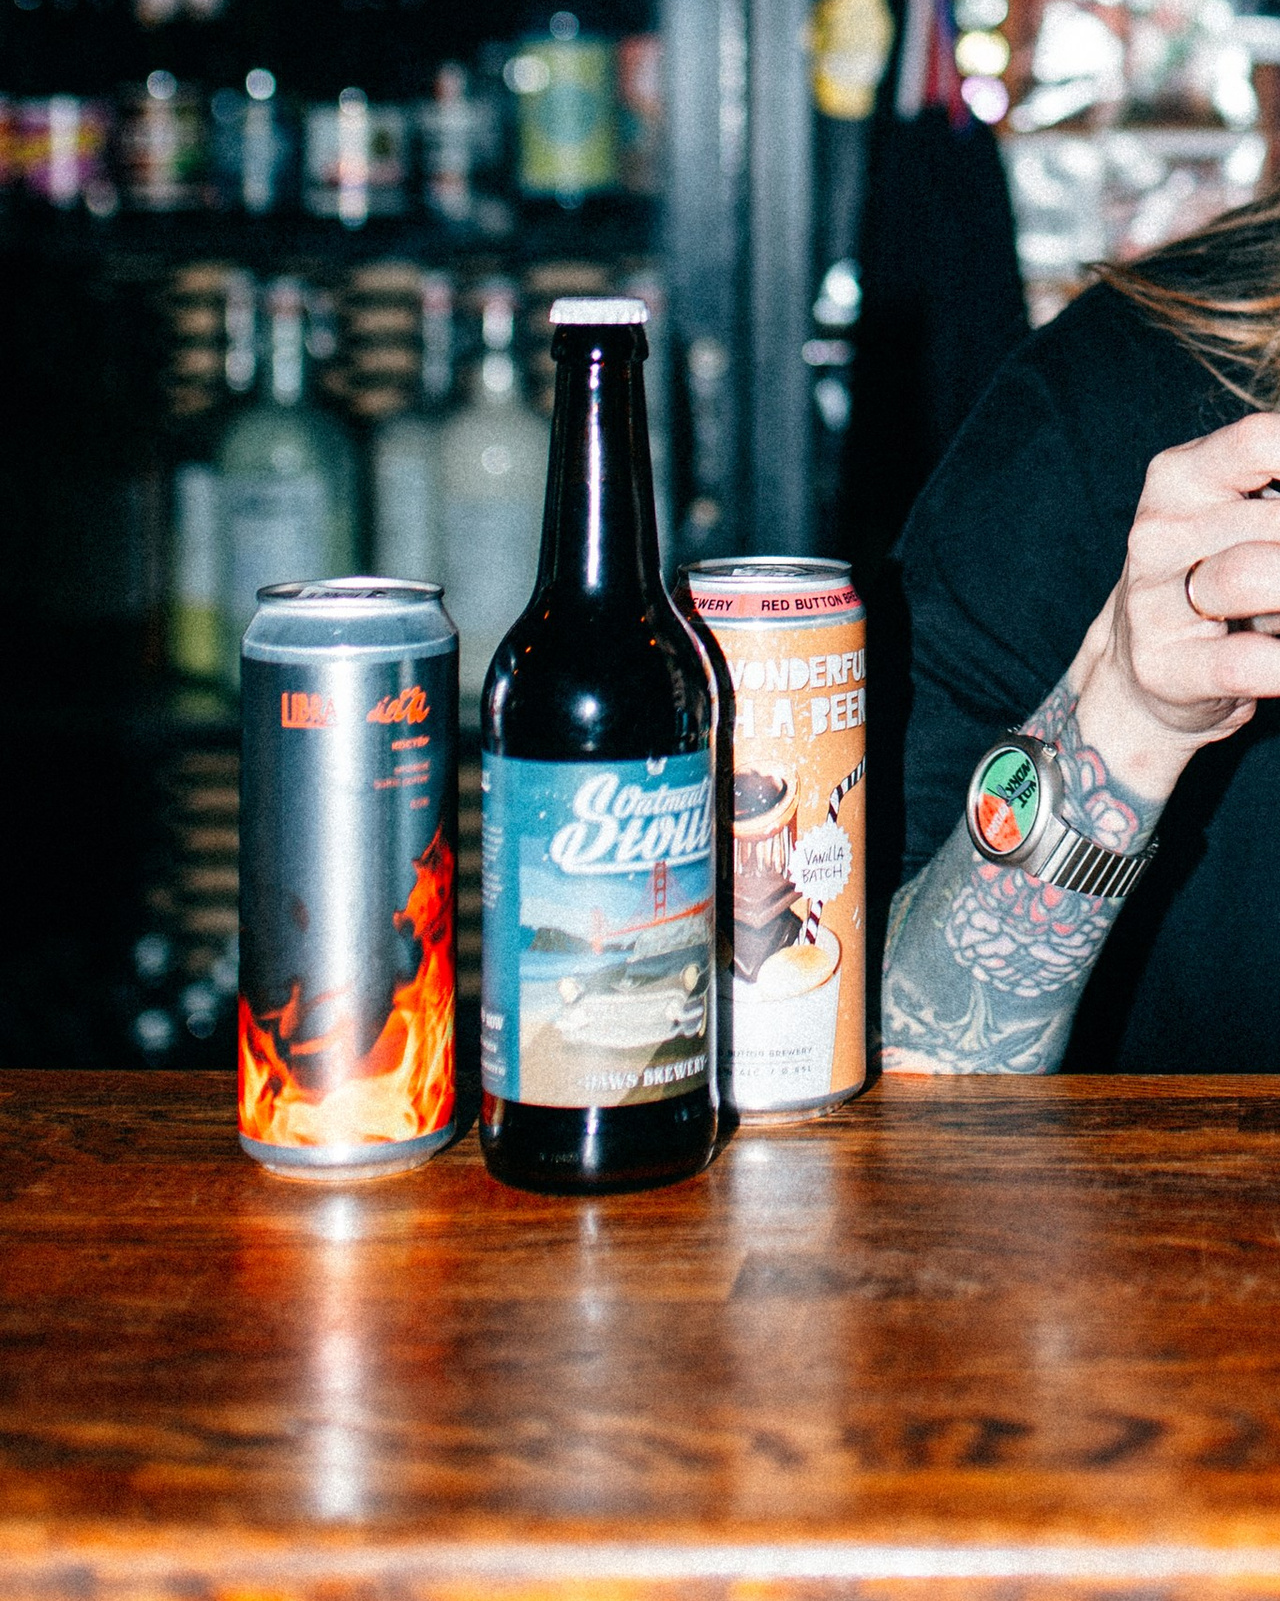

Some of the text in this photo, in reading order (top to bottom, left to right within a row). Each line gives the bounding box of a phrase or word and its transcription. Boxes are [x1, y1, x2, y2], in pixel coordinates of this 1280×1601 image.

[693, 598, 733, 612] EWERY
[761, 599, 790, 611] RED
[795, 595, 843, 610] BUTTON
[613, 776, 708, 819] Oatmeal
[551, 772, 712, 872] Stout
[804, 846, 844, 865] VANILLA
[802, 865, 843, 882] BATCH
[769, 1046, 812, 1058] BREWERY
[643, 1055, 706, 1087] BREWERY
